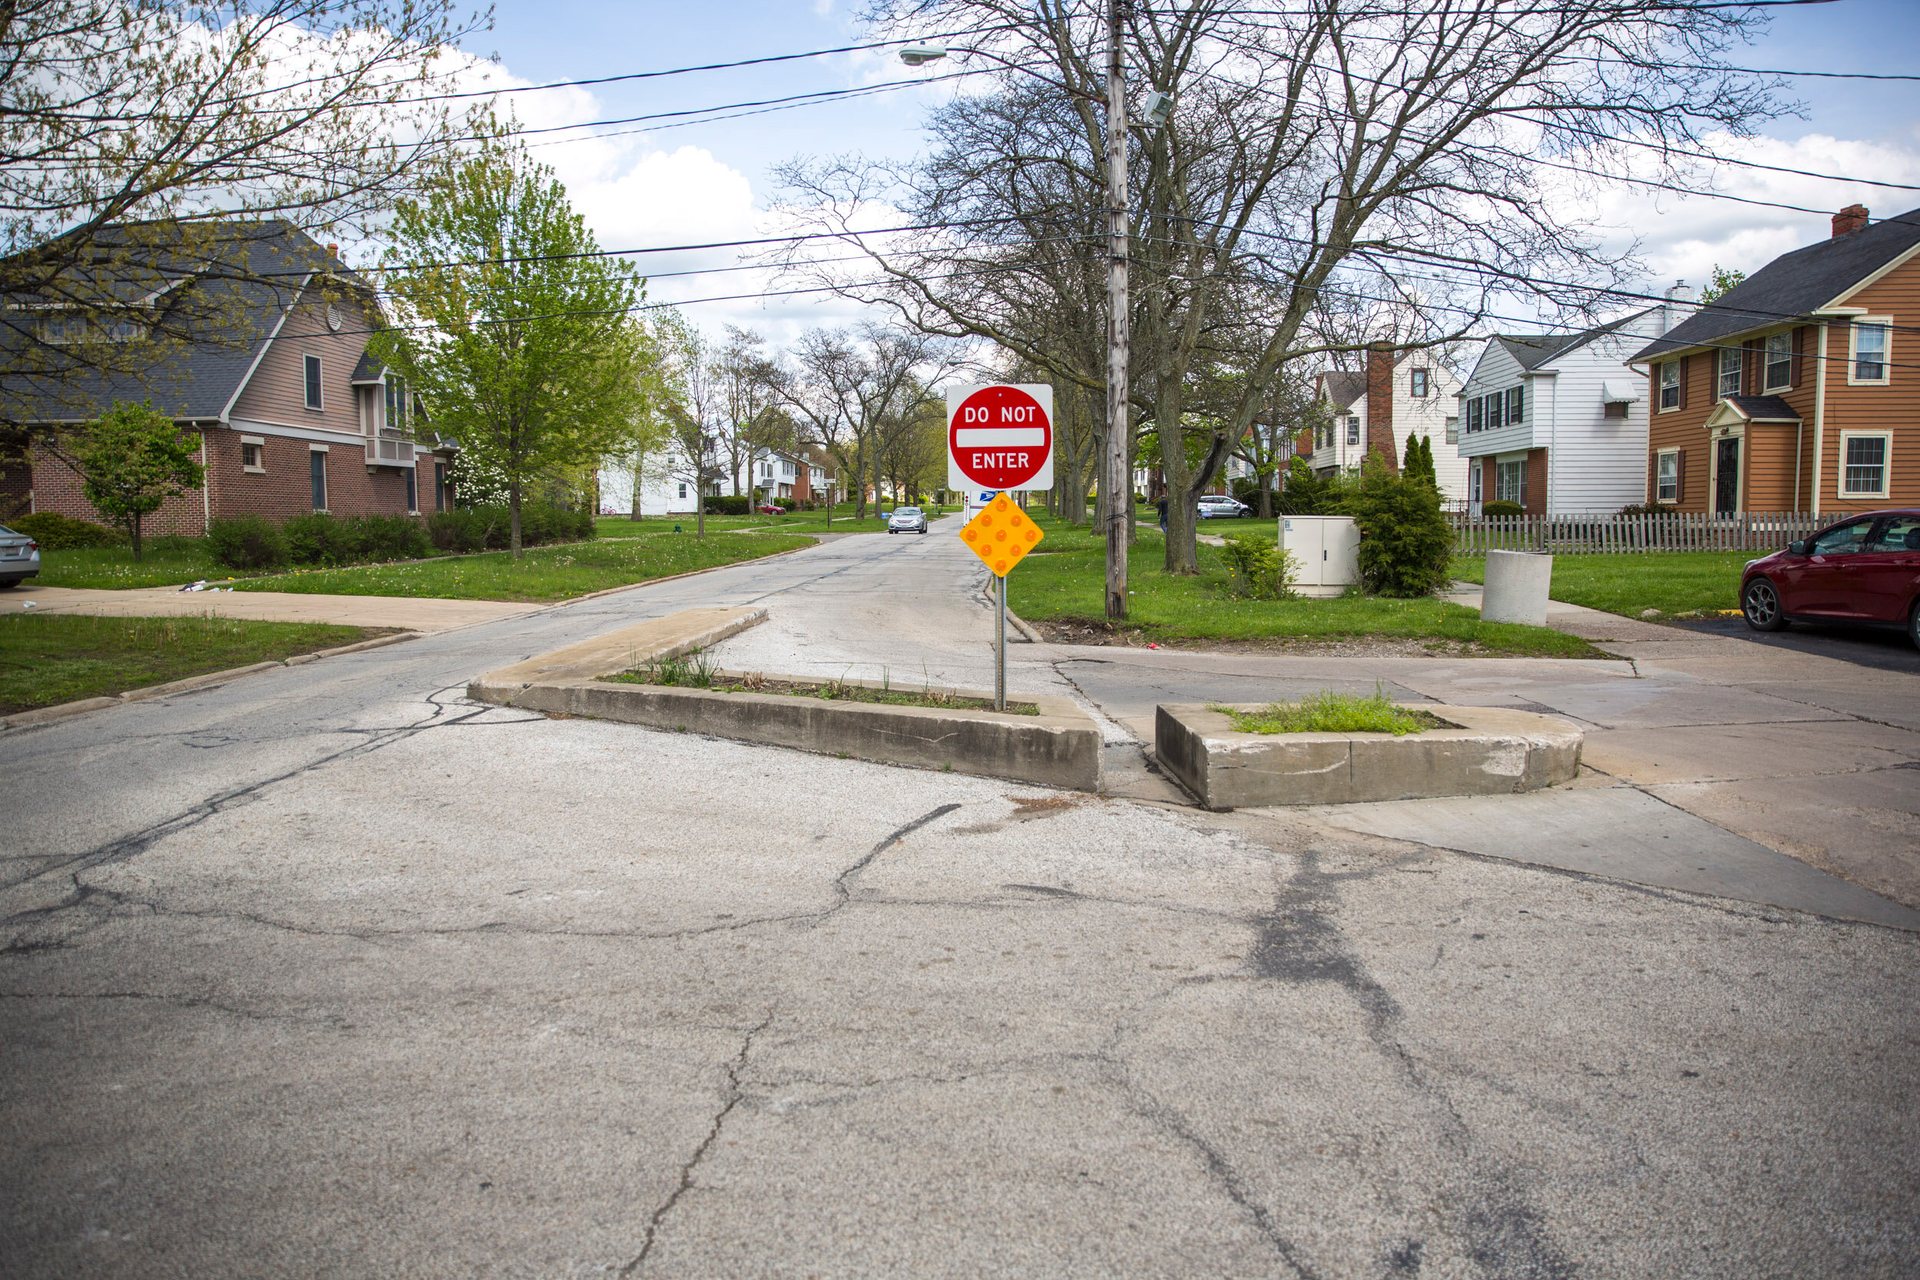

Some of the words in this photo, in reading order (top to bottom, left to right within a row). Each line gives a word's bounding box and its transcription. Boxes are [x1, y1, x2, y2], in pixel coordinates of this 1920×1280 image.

[965, 407, 989, 423] DO
[1001, 406, 1036, 422] NOT
[972, 453, 1029, 469] ENTER
